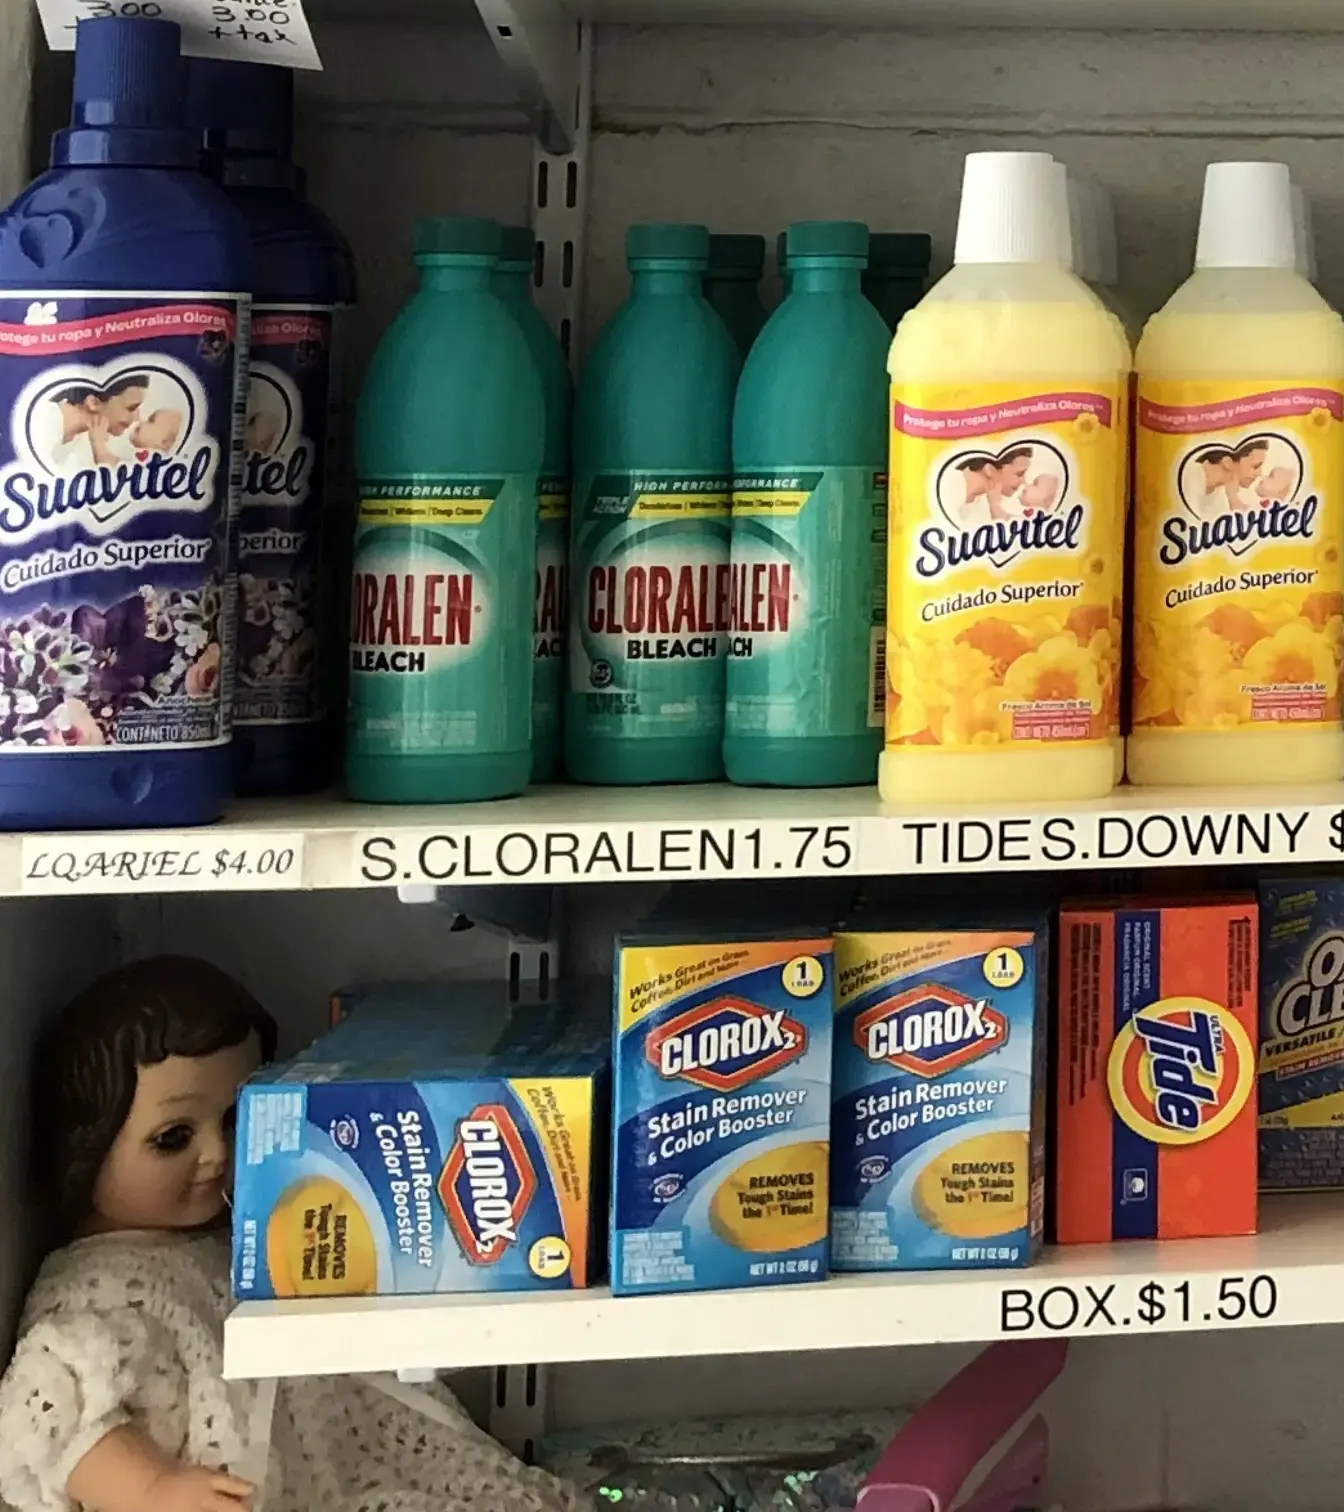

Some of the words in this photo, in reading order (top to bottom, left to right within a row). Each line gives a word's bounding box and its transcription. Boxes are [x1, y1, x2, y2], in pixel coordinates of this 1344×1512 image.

[105, 312, 181, 334] Neutraliza
[1, 446, 212, 533] Suavitel
[916, 504, 1084, 577] Suavitel
[1160, 495, 1318, 565] Suavitel
[4, 542, 98, 588] Cuidado
[104, 538, 206, 567] Superior
[920, 589, 997, 622] Cuidado
[1001, 582, 1079, 604] Superior
[1165, 577, 1235, 609] Cuidado
[1240, 570, 1314, 591] Superior
[627, 638, 716, 659] BLEACH
[212, 849, 294, 877] $4.00
[1210, 1015, 1223, 1053] ULTRA
[1266, 1027, 1336, 1057] VERSATILE
[1135, 1012, 1218, 1130] Tide
[648, 1106, 709, 1139] Stain
[712, 1089, 807, 1118] Remover
[855, 1092, 912, 1120] Stain
[916, 1077, 1007, 1102] Remover
[868, 1114, 916, 1141] Color
[922, 1099, 995, 1122] Booster
[397, 1110, 426, 1171] Stain
[661, 1129, 712, 1160] Color
[719, 1109, 794, 1139] Booster
[411, 1171, 433, 1268] Remover
